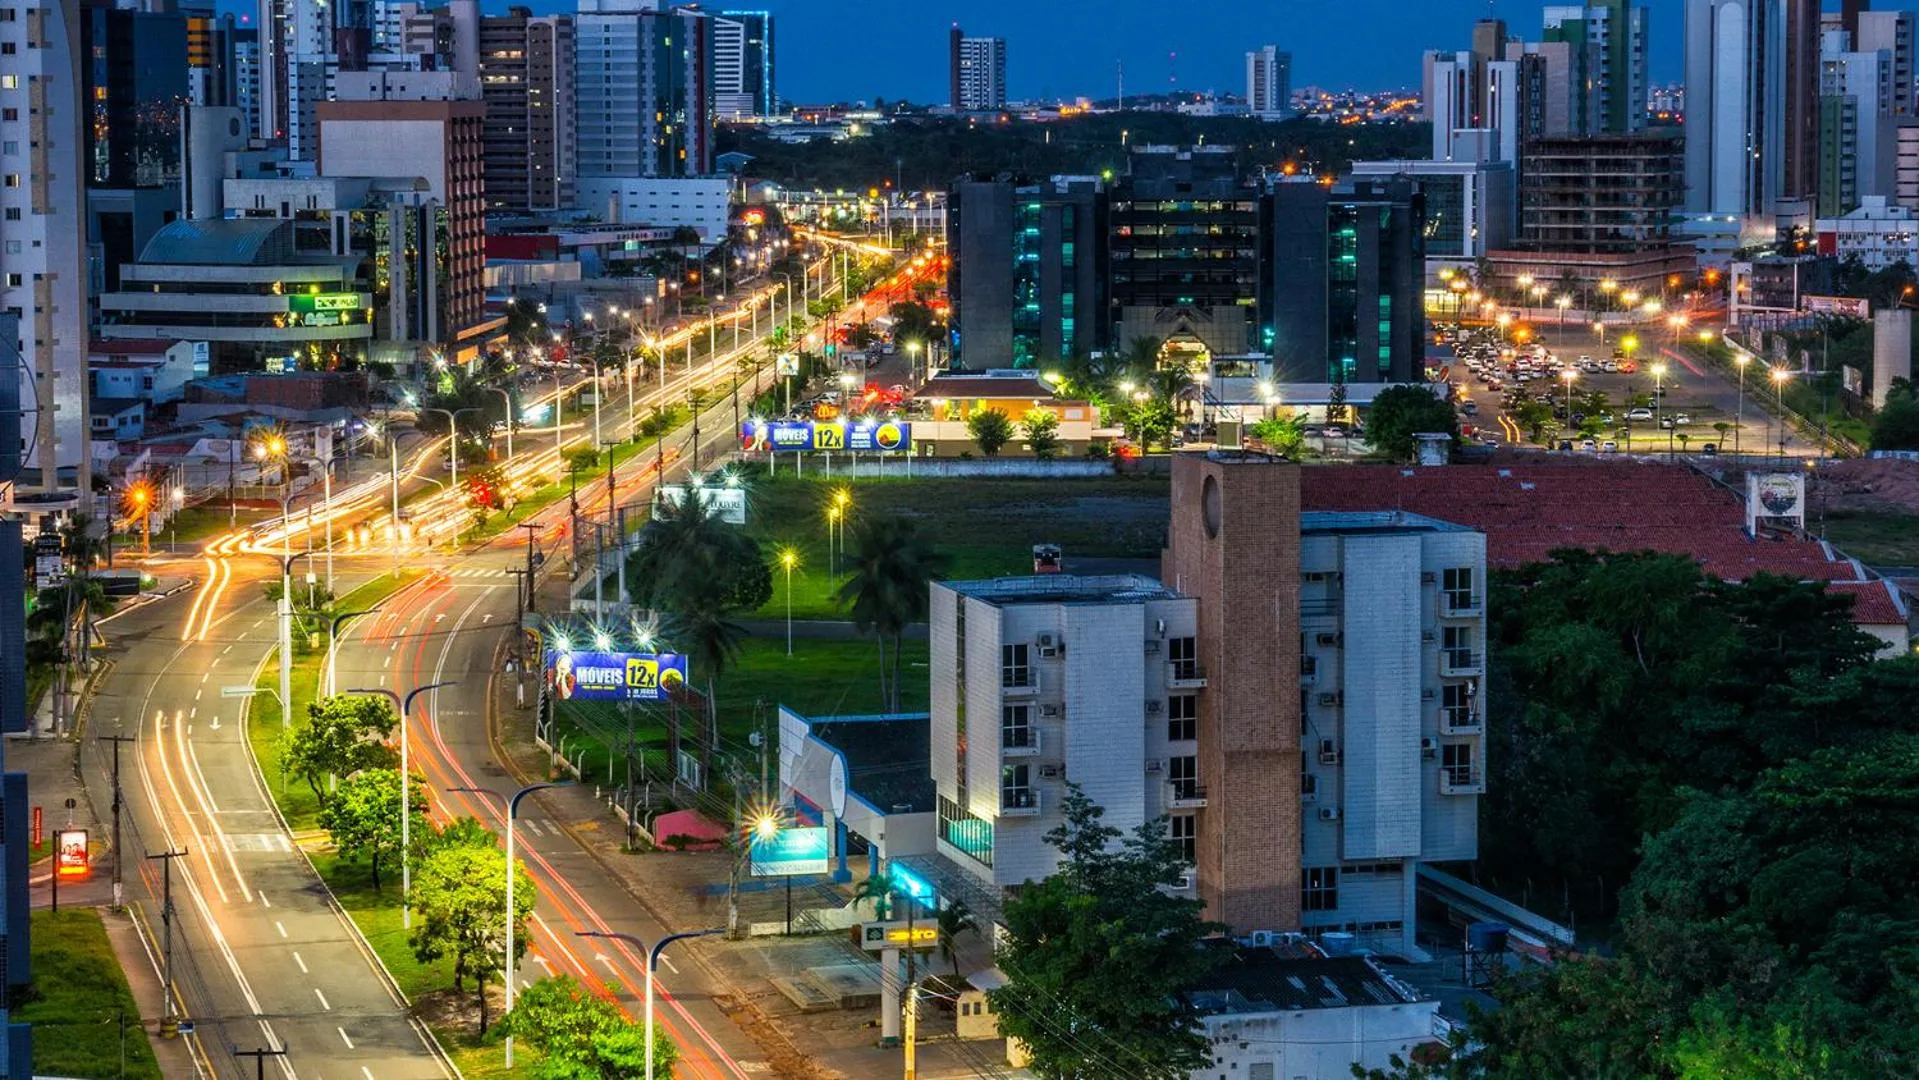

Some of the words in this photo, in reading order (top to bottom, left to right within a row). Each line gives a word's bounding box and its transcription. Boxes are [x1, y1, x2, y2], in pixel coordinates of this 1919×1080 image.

[774, 428, 809, 441] MÓVEIS
[816, 429, 842, 448] 12x
[576, 666, 624, 685] MÓVEIS
[629, 666, 655, 687] 12x
